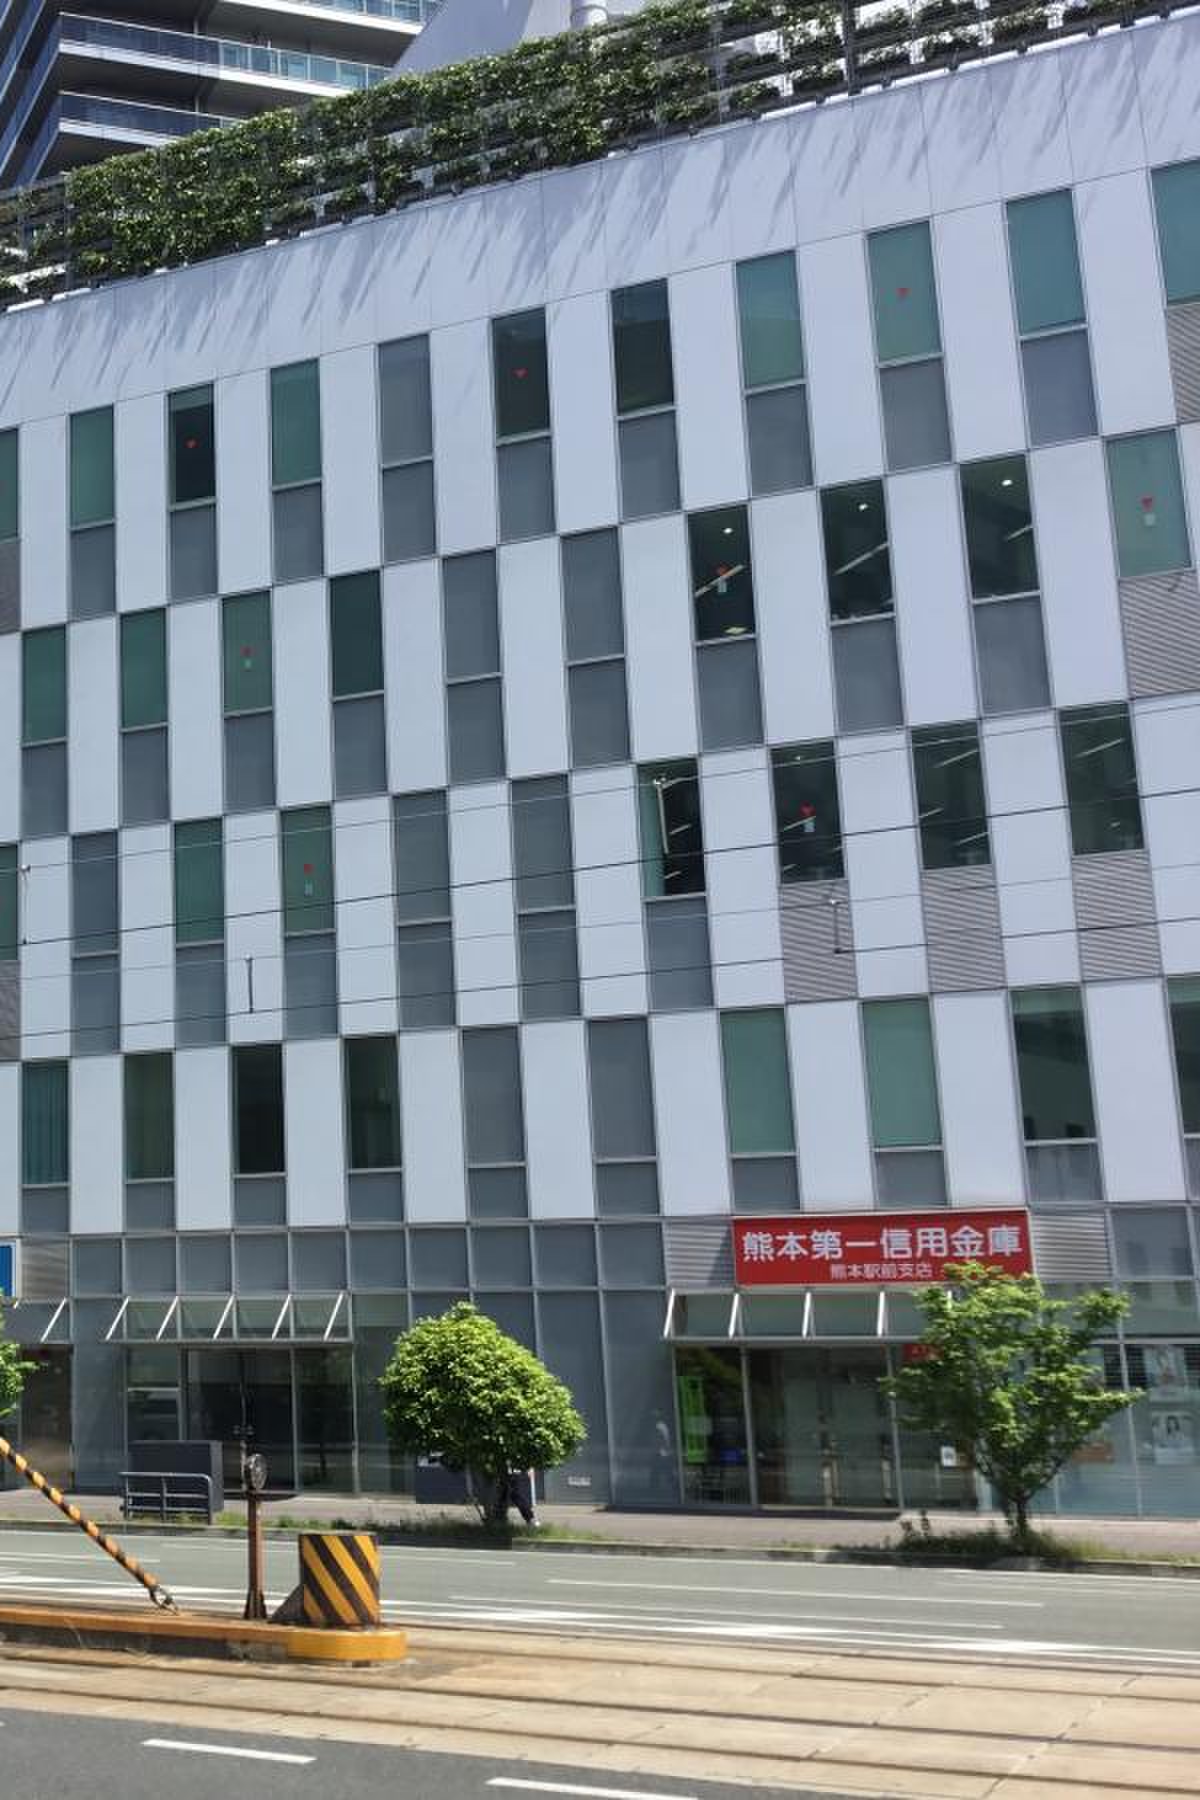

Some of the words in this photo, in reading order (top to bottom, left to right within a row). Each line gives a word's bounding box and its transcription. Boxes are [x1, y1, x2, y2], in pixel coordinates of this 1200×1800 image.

[742, 1226, 1022, 1262] 熊本第一信用金庫
